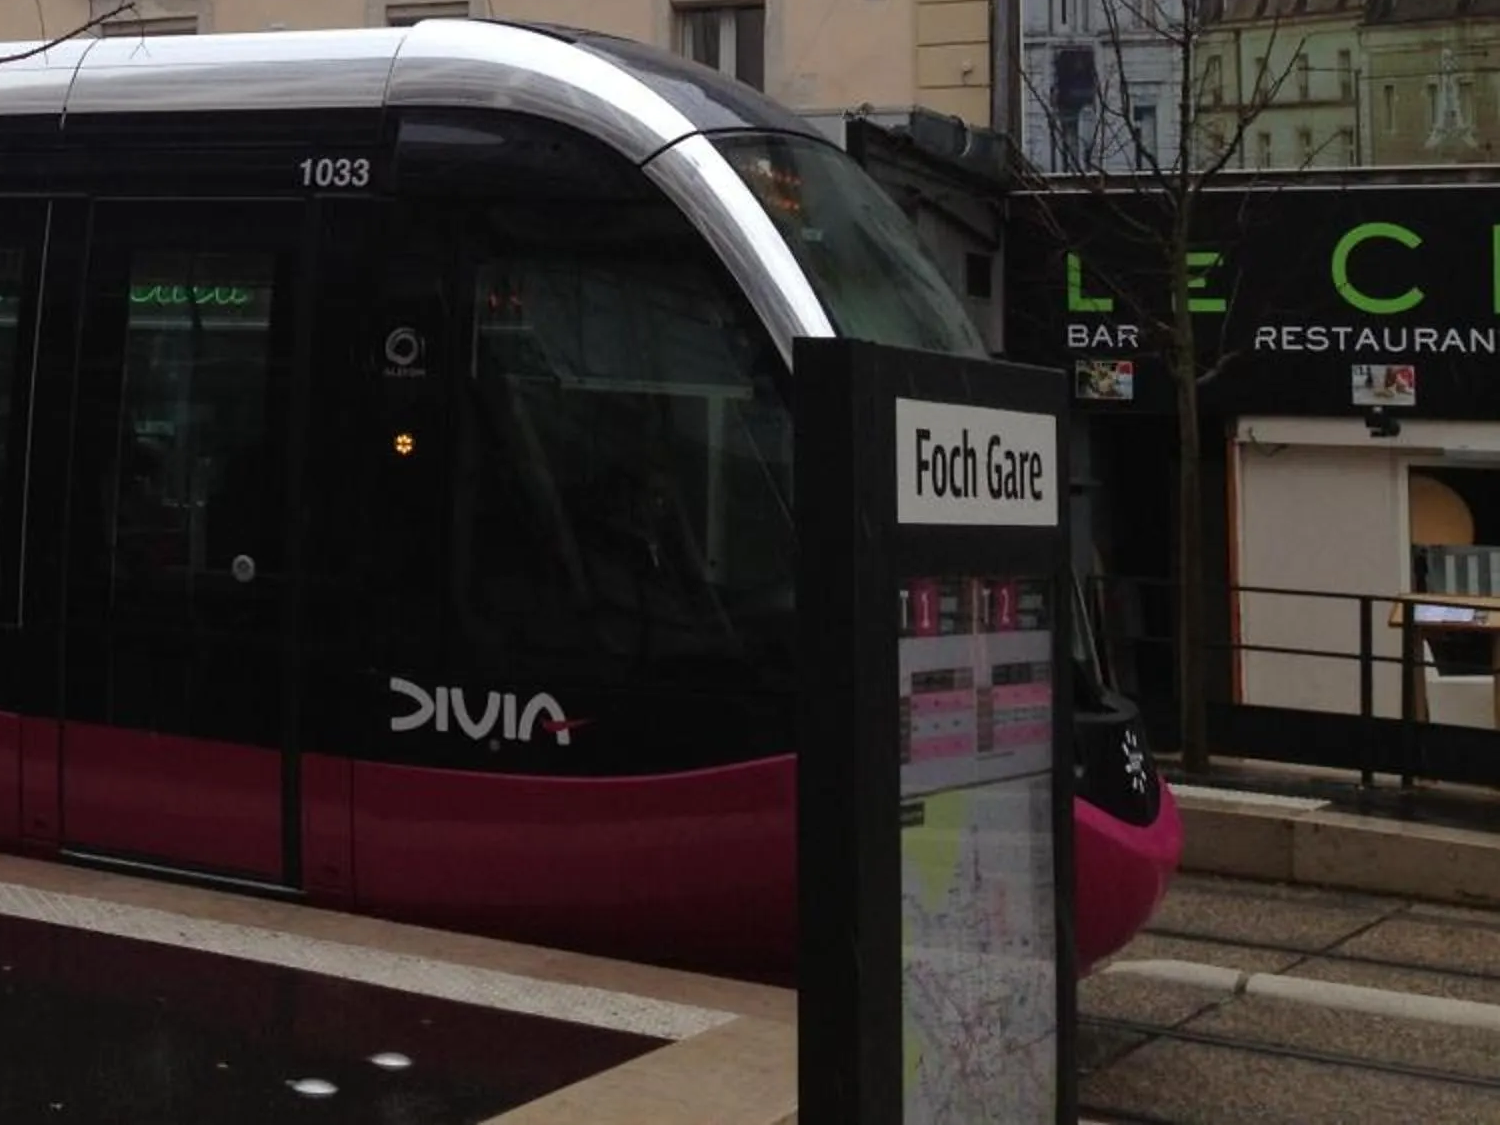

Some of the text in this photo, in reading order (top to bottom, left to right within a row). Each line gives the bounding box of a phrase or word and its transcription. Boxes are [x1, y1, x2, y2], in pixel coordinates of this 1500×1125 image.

[299, 158, 370, 187] 1033
[1066, 221, 1500, 315] LE C
[1067, 324, 1140, 349] BAR
[1254, 326, 1498, 353] RESTAURAN
[916, 428, 1043, 502] Foch Gare
